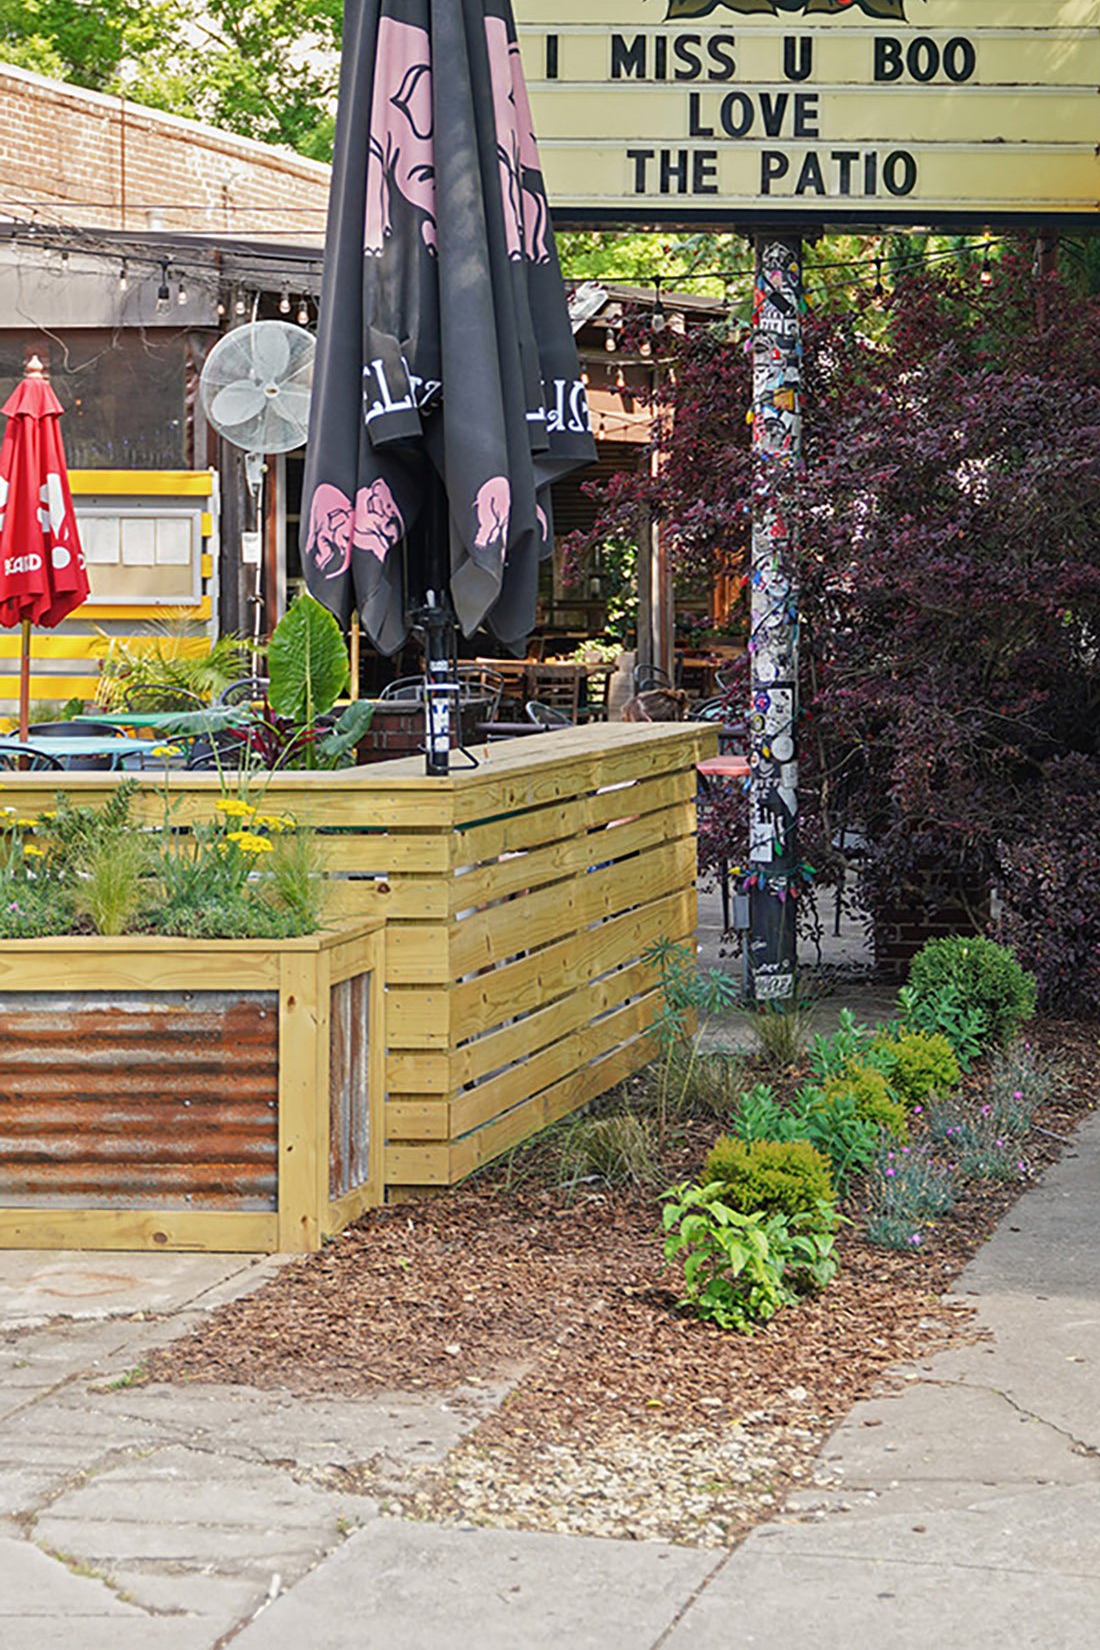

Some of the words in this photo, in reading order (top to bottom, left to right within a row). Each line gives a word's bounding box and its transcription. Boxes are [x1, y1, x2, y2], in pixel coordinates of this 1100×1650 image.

[546, 34, 559, 79] I
[610, 34, 736, 81] MISS
[783, 35, 813, 81] U
[873, 35, 977, 82] BOO
[688, 91, 820, 138] LOVE
[626, 149, 719, 195] THE
[760, 150, 918, 196] PATIO
